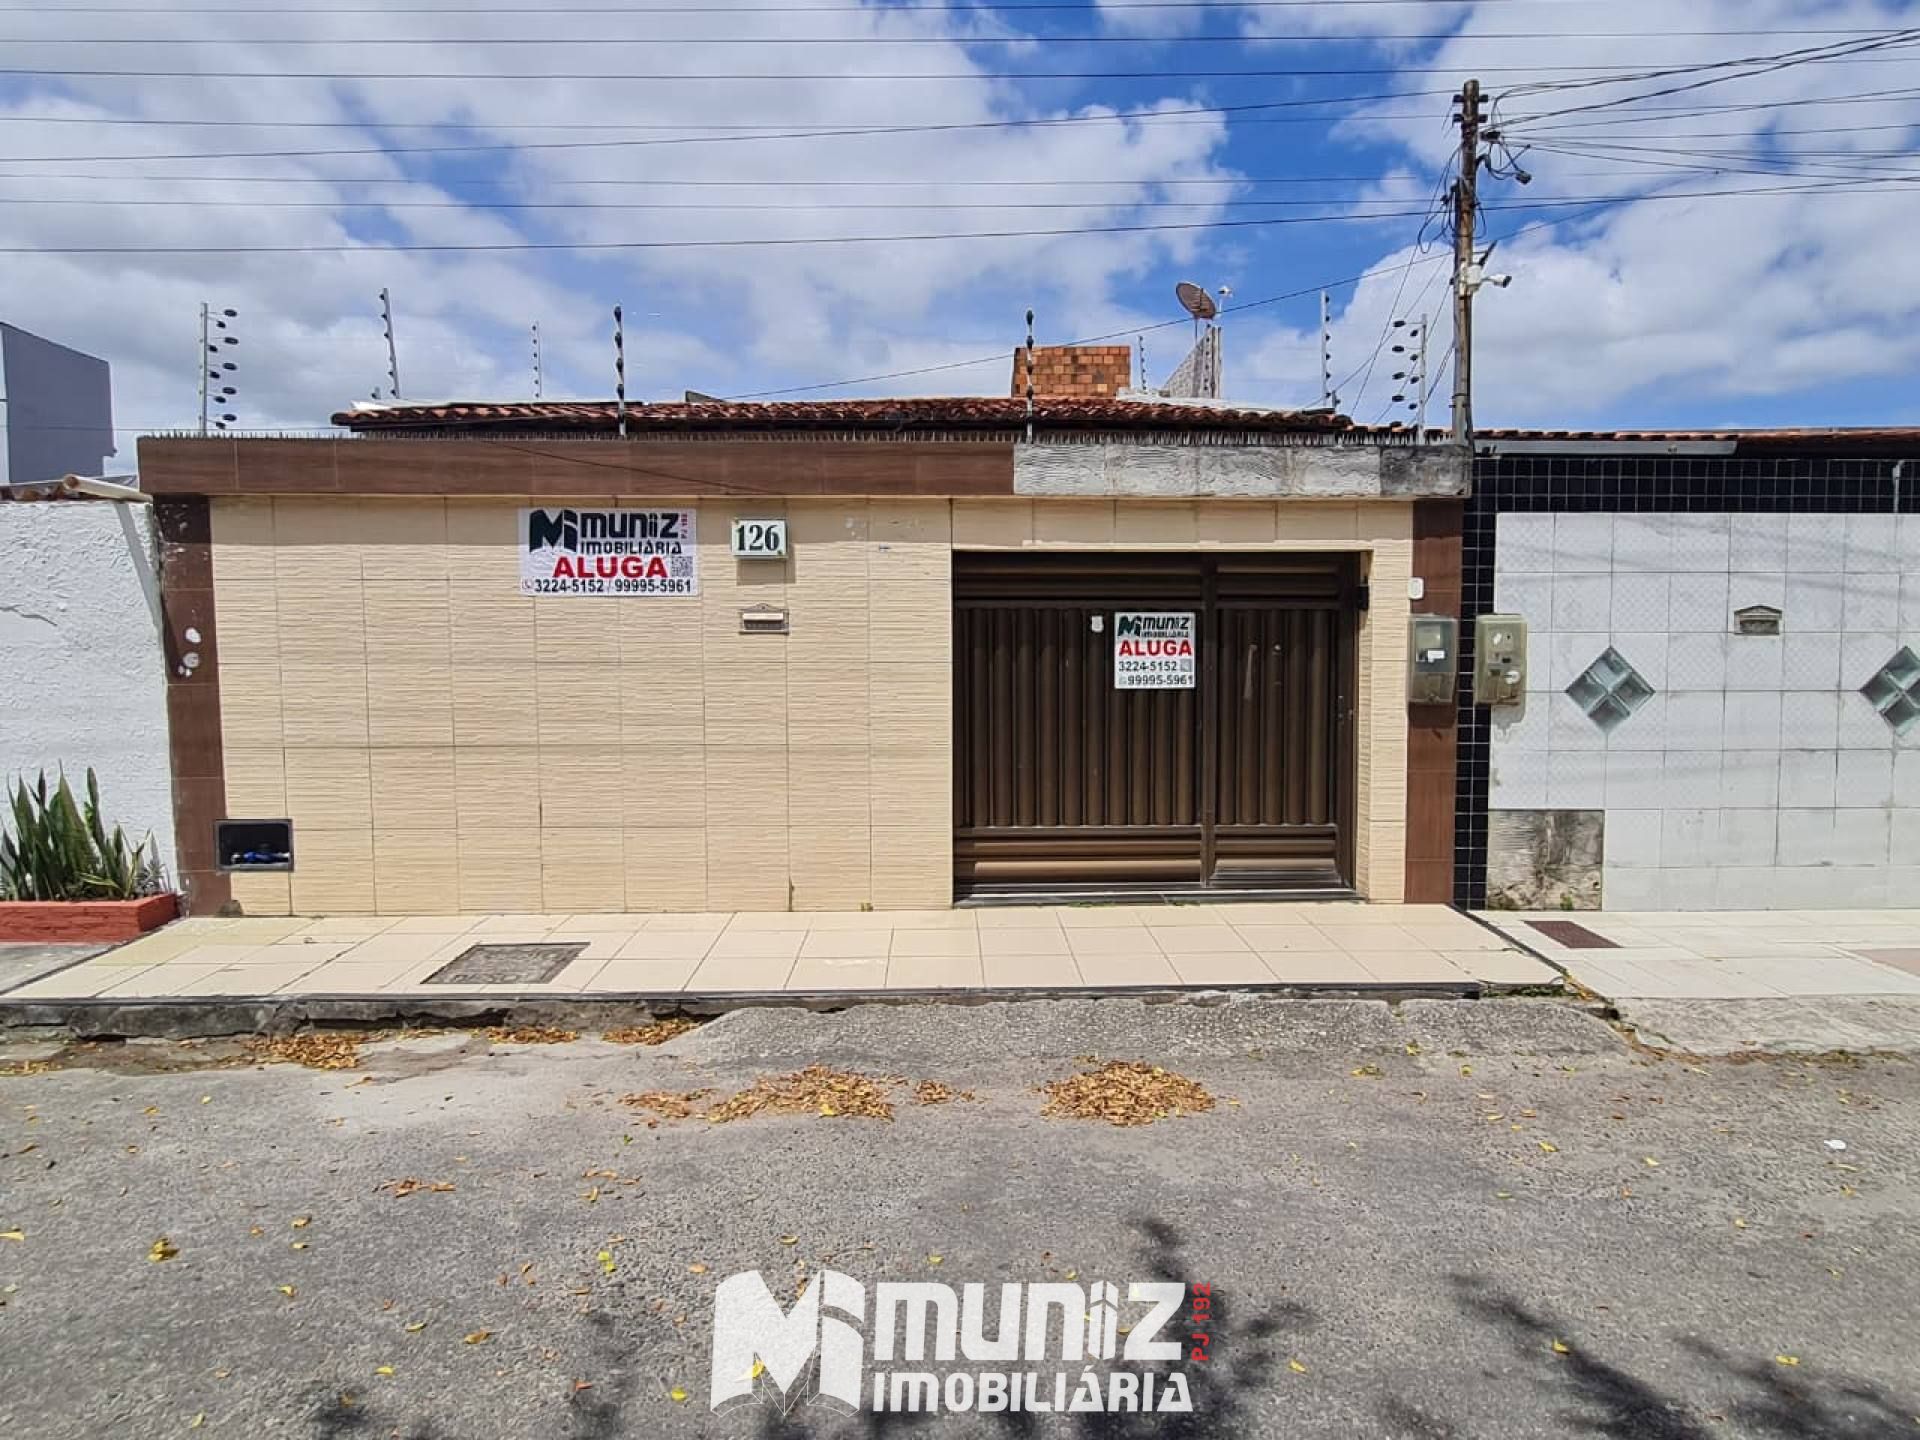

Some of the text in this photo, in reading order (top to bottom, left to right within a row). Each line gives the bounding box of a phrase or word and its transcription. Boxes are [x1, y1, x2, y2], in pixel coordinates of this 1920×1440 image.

[737, 524, 780, 551] 126
[553, 556, 668, 578] ALUGA
[534, 579, 604, 593] 3224-5152
[614, 579, 691, 593] 99995-5961
[1119, 640, 1192, 656] ALUGA
[1119, 660, 1177, 672] 3224-5152
[1127, 674, 1193, 685] 99995-5961
